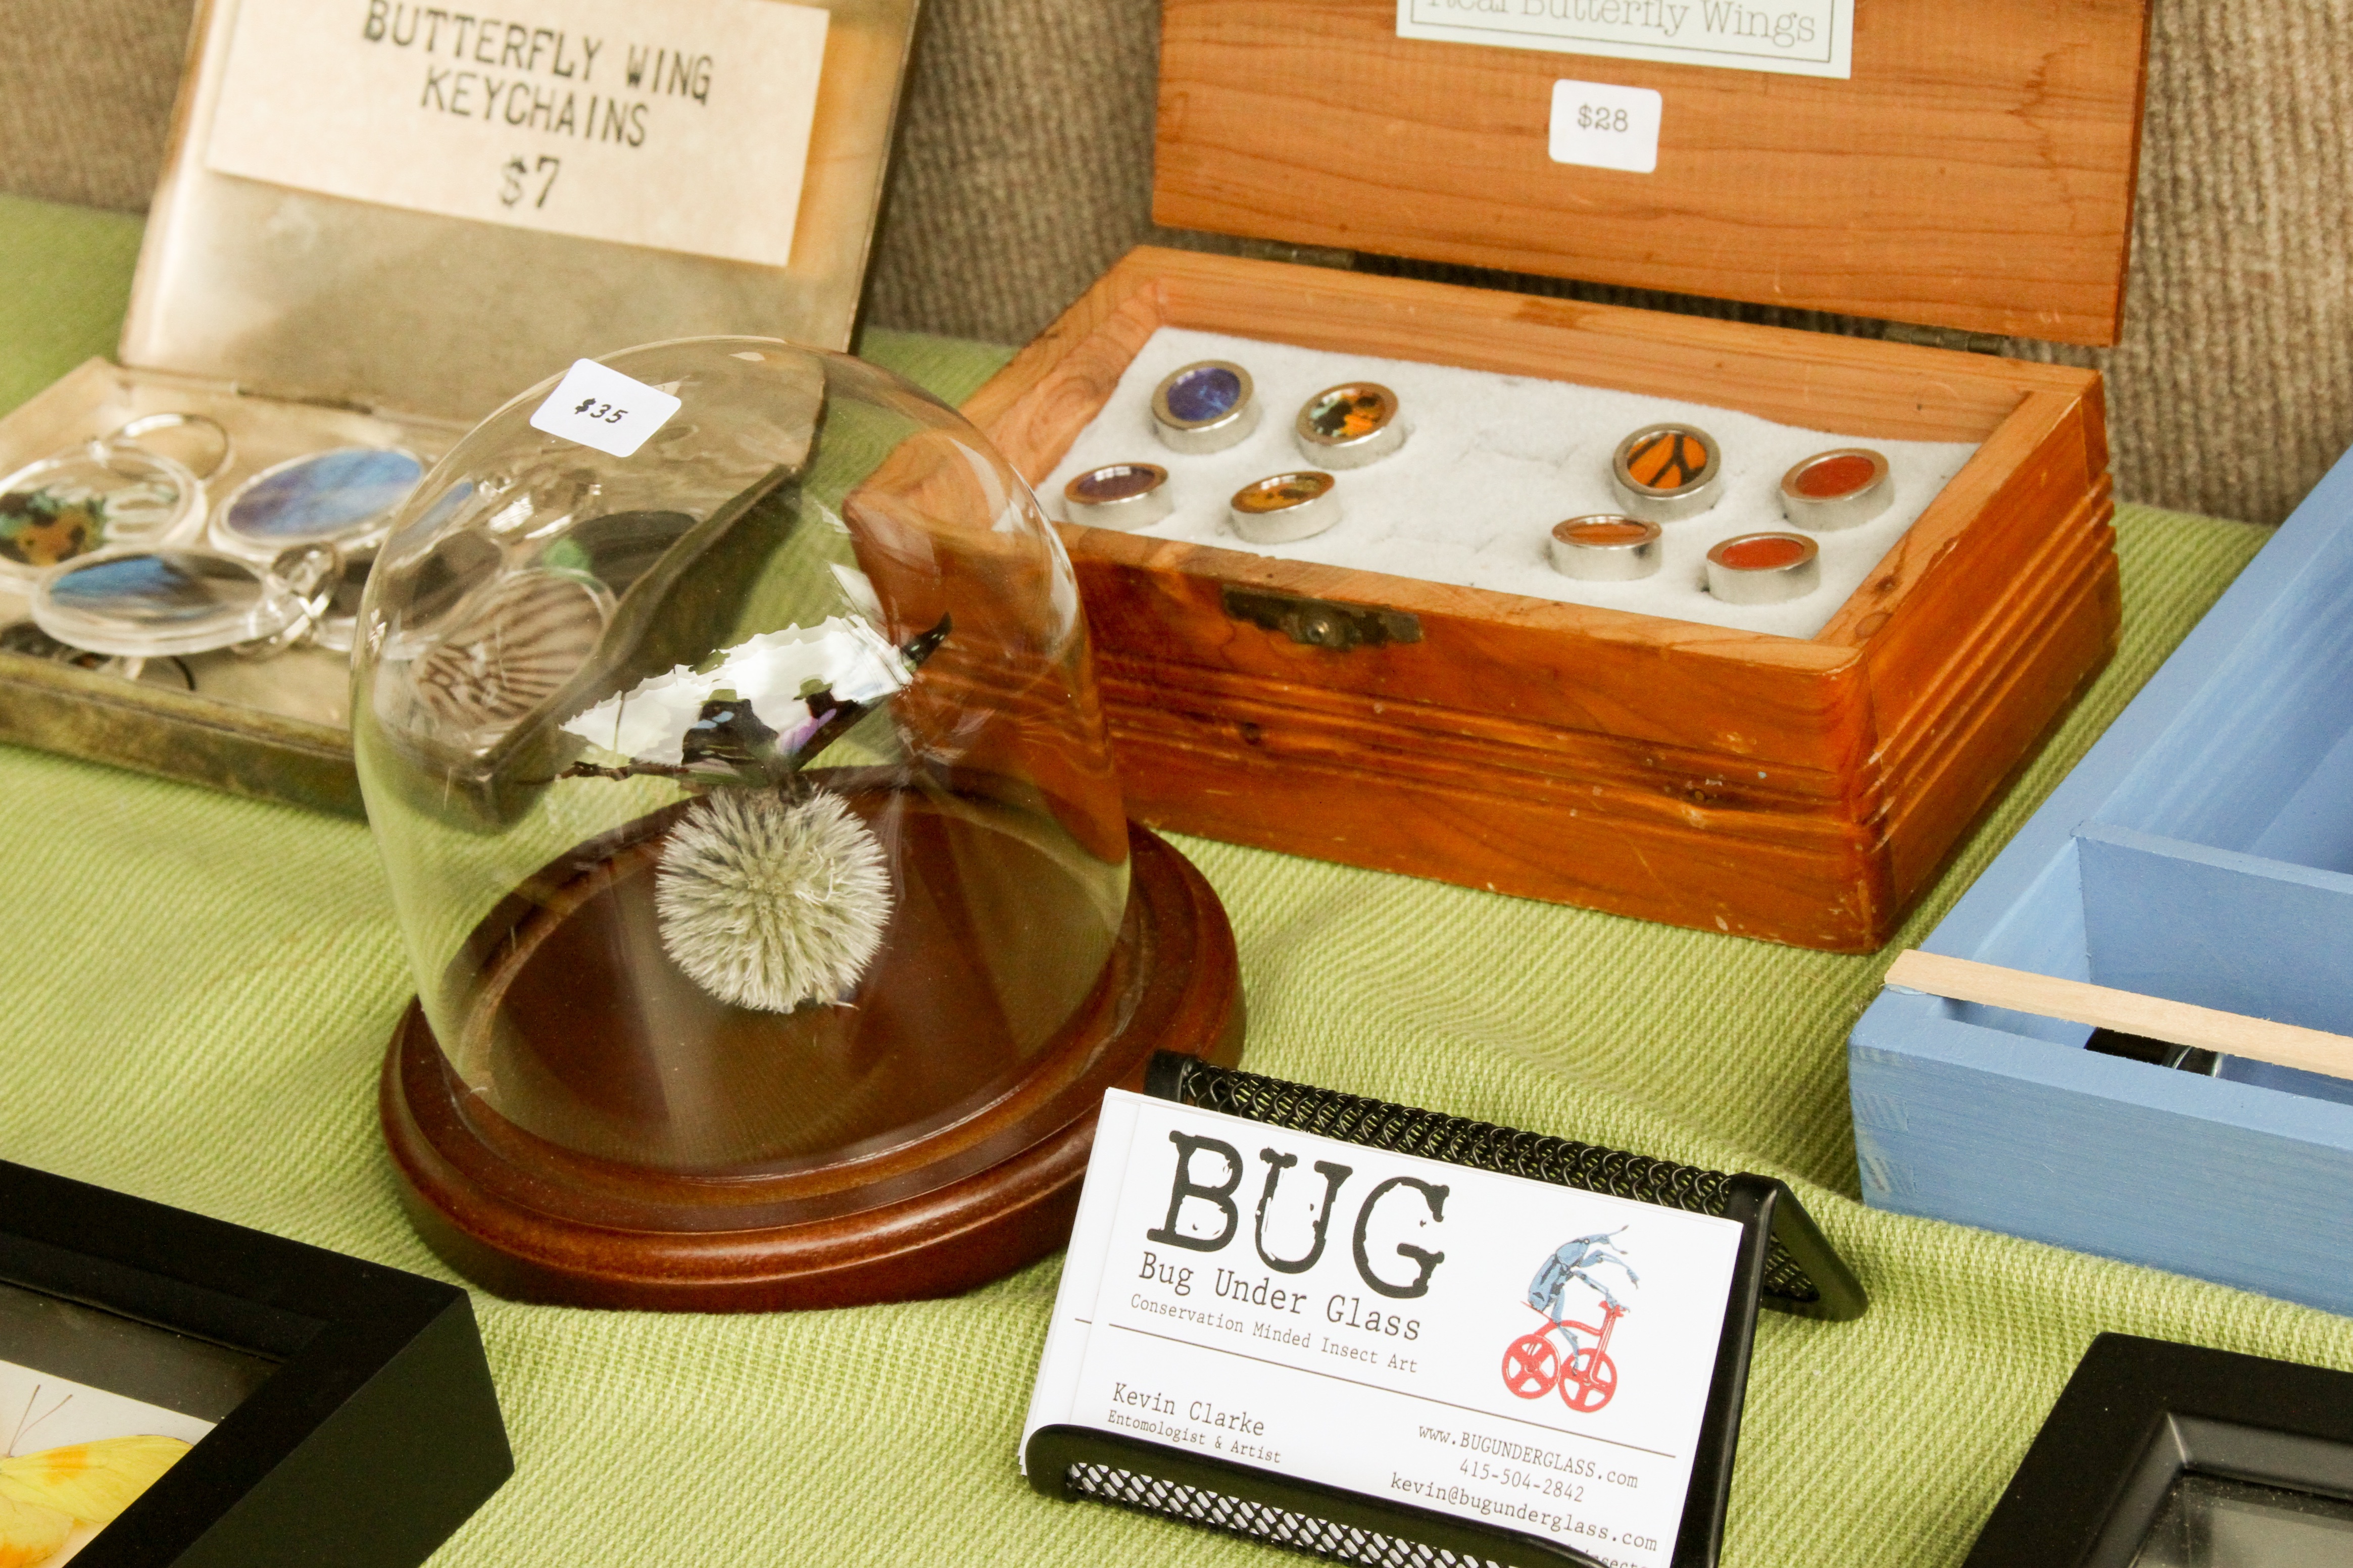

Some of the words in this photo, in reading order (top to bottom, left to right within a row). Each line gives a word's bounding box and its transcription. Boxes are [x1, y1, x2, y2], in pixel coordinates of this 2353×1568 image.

[363, 0, 602, 81] BUTTERFLY
[627, 43, 714, 106] WING
[1702, 0, 1816, 48] Wings
[421, 64, 650, 148] KEYCHAINS
[1577, 103, 1628, 132] $28
[498, 153, 562, 209] $7
[574, 398, 628, 423] $35
[1146, 1130, 1450, 1299] BUG
[1139, 1251, 1194, 1296] Bug
[1214, 1268, 1308, 1315] Under
[1327, 1294, 1421, 1341] Glass
[1131, 1293, 1244, 1334] Conservation
[1252, 1321, 1312, 1349] Minded
[1320, 1337, 1379, 1364] Insect
[1387, 1353, 1418, 1374] Art
[1107, 1409, 1206, 1445] Entomologist
[1214, 1436, 1222, 1450] &
[1231, 1440, 1281, 1463] Artist
[1112, 1382, 1176, 1415] Kevin
[1189, 1401, 1265, 1437] Clarke
[1418, 1425, 1639, 1489] www.BUGUNDERGLASS.com
[1459, 1458, 1585, 1503] 415-504-2842
[1390, 1472, 1658, 1552] kevin@bugunderglass.com
